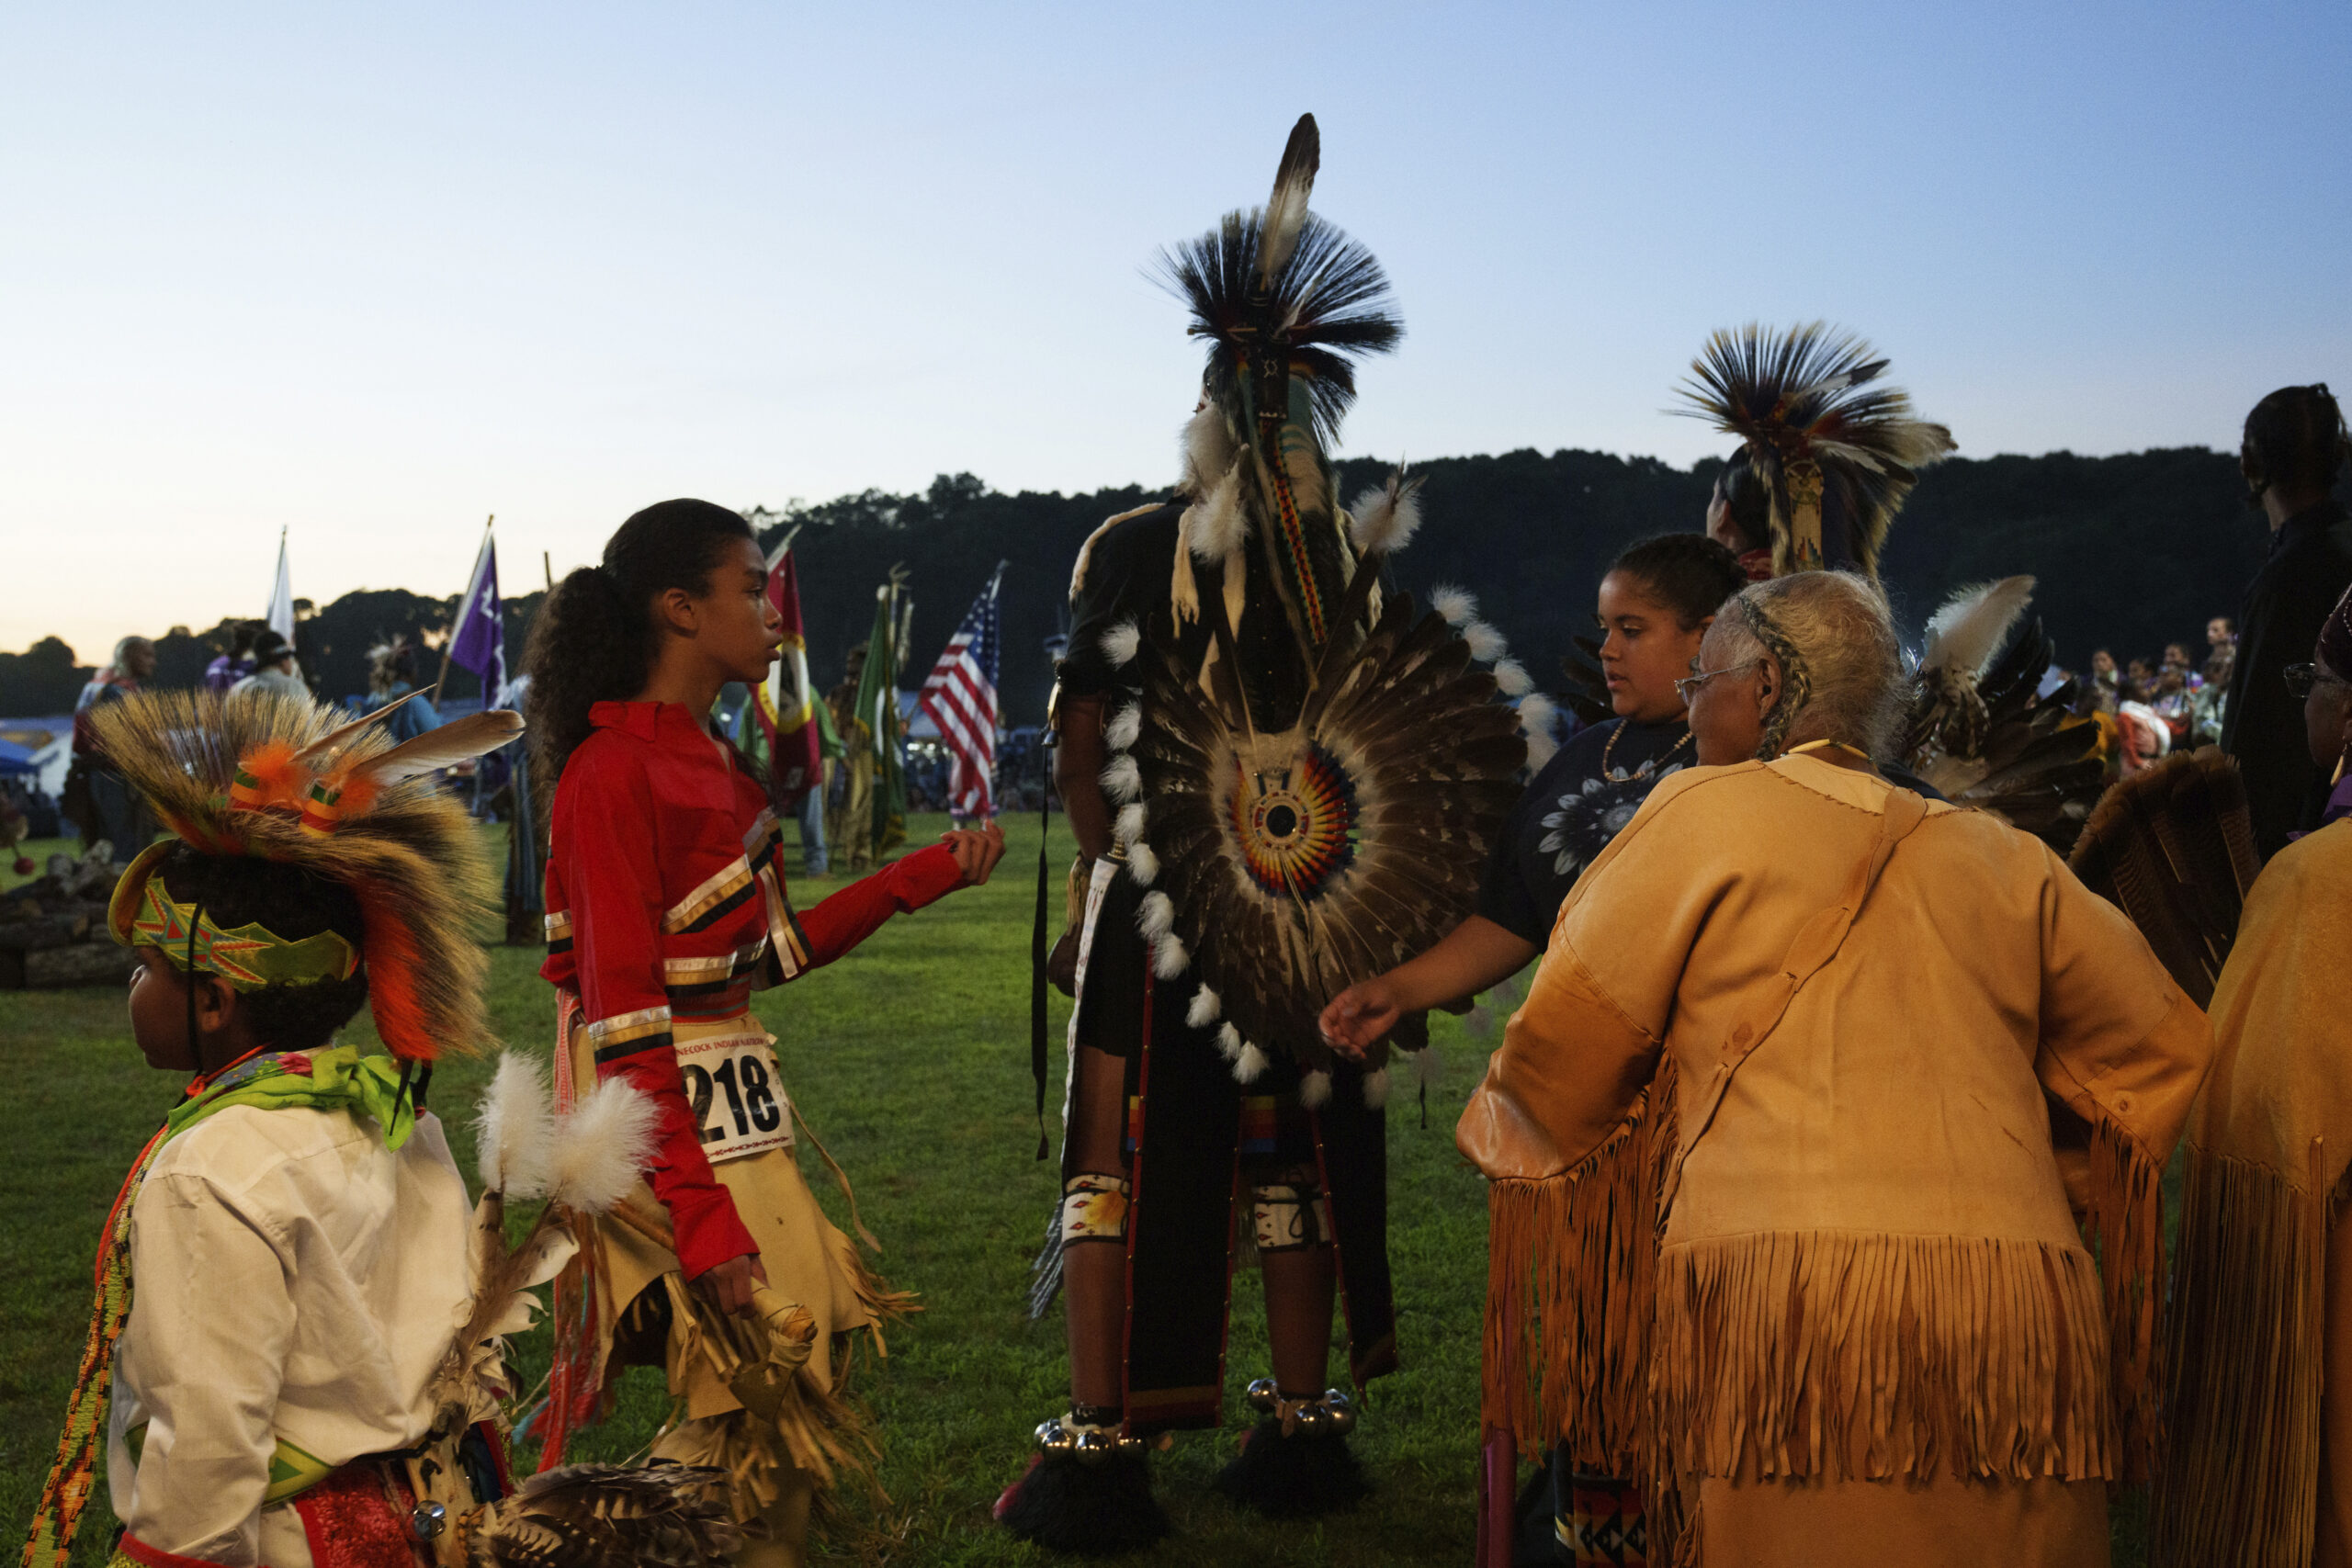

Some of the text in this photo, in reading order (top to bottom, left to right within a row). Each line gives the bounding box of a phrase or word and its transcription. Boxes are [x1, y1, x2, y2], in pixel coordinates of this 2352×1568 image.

[676, 1043, 712, 1055] NECOCK
[714, 1040, 740, 1049] INDIAN
[683, 1055, 780, 1144] 218
